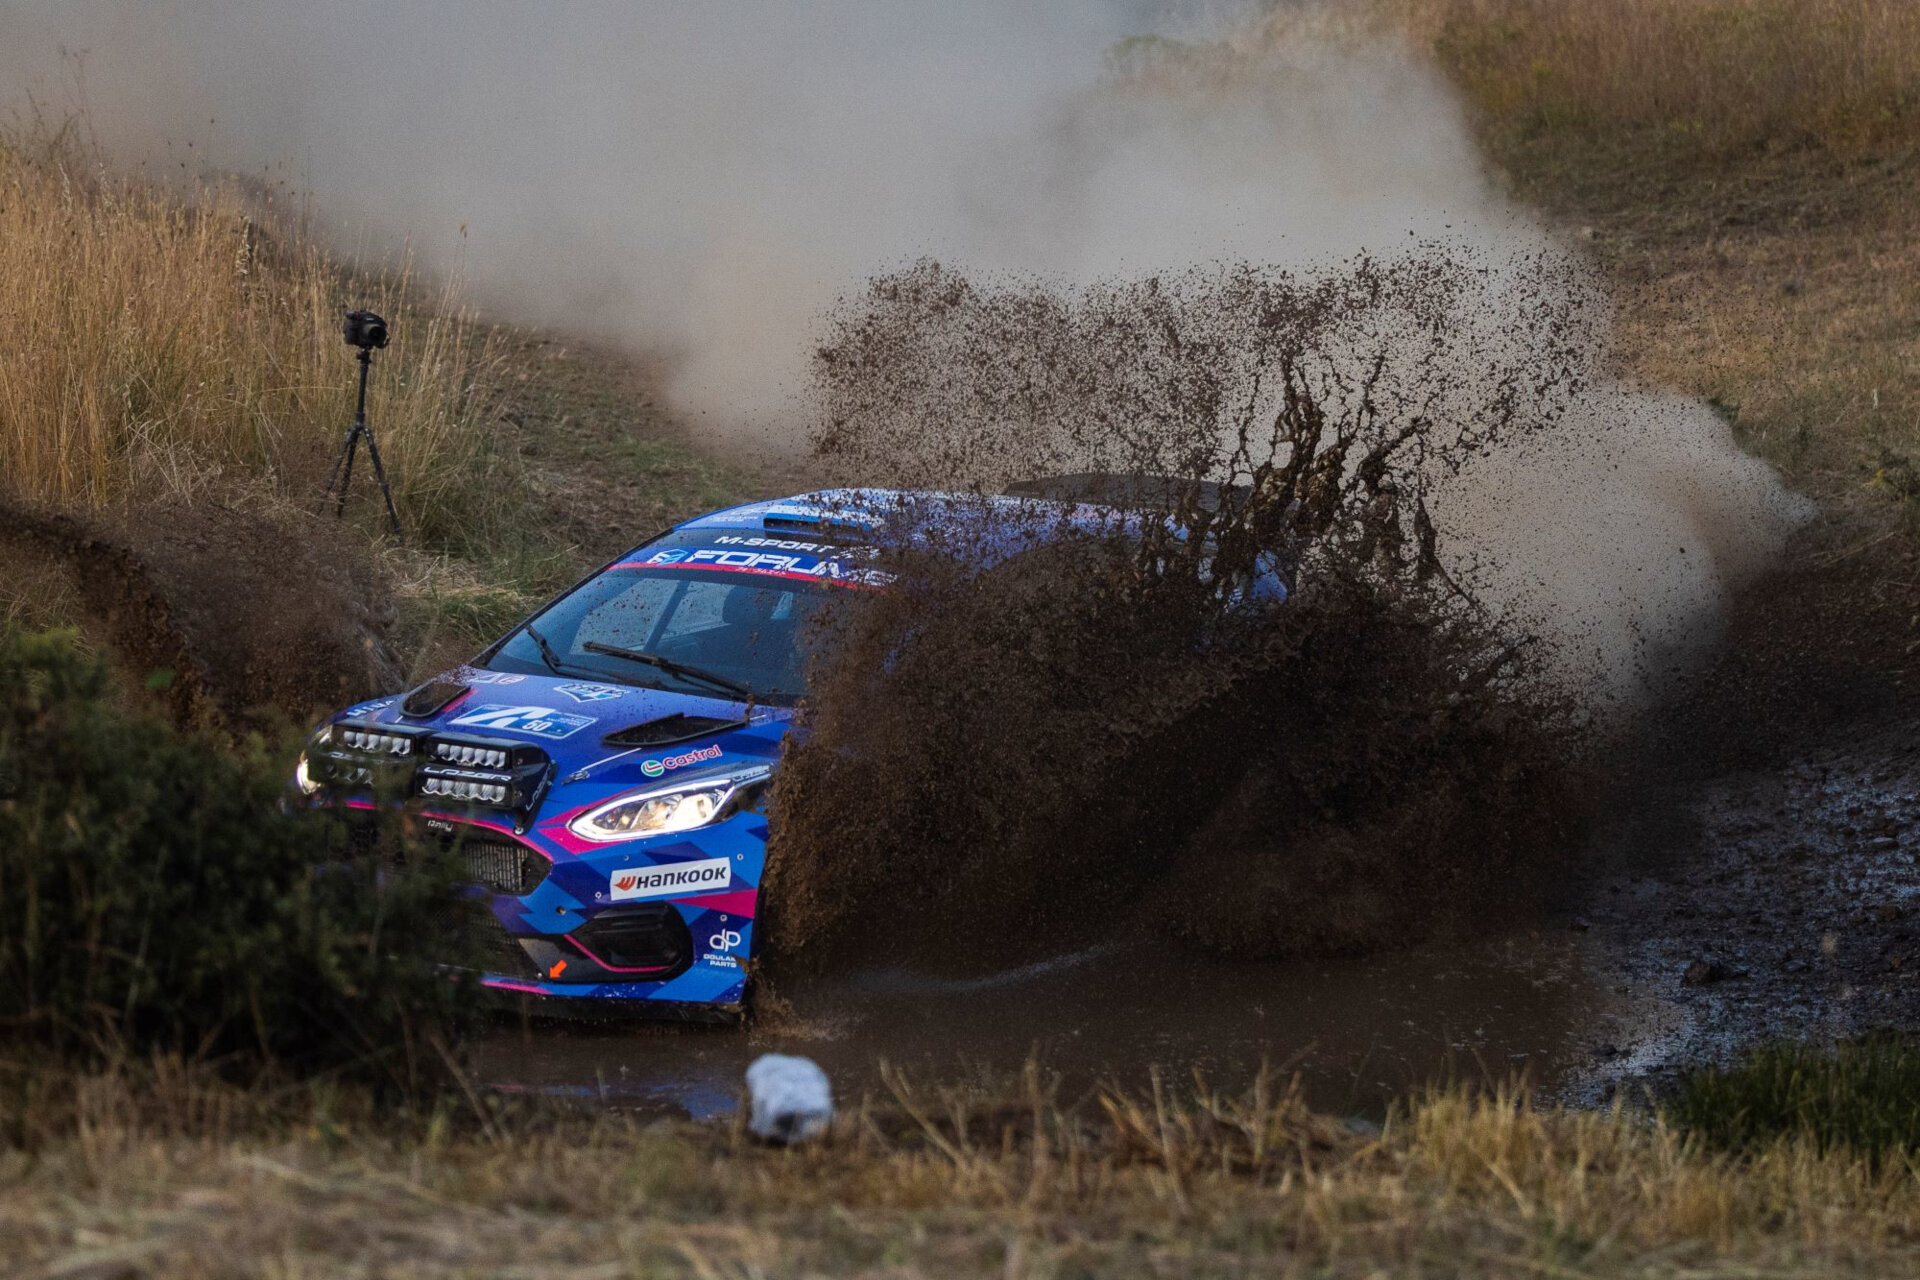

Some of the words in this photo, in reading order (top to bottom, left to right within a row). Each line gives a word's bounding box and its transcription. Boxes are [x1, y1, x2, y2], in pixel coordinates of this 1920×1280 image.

[663, 744, 723, 769] Castrol
[424, 766, 512, 782] LAZER
[709, 960, 738, 969] PARTS
